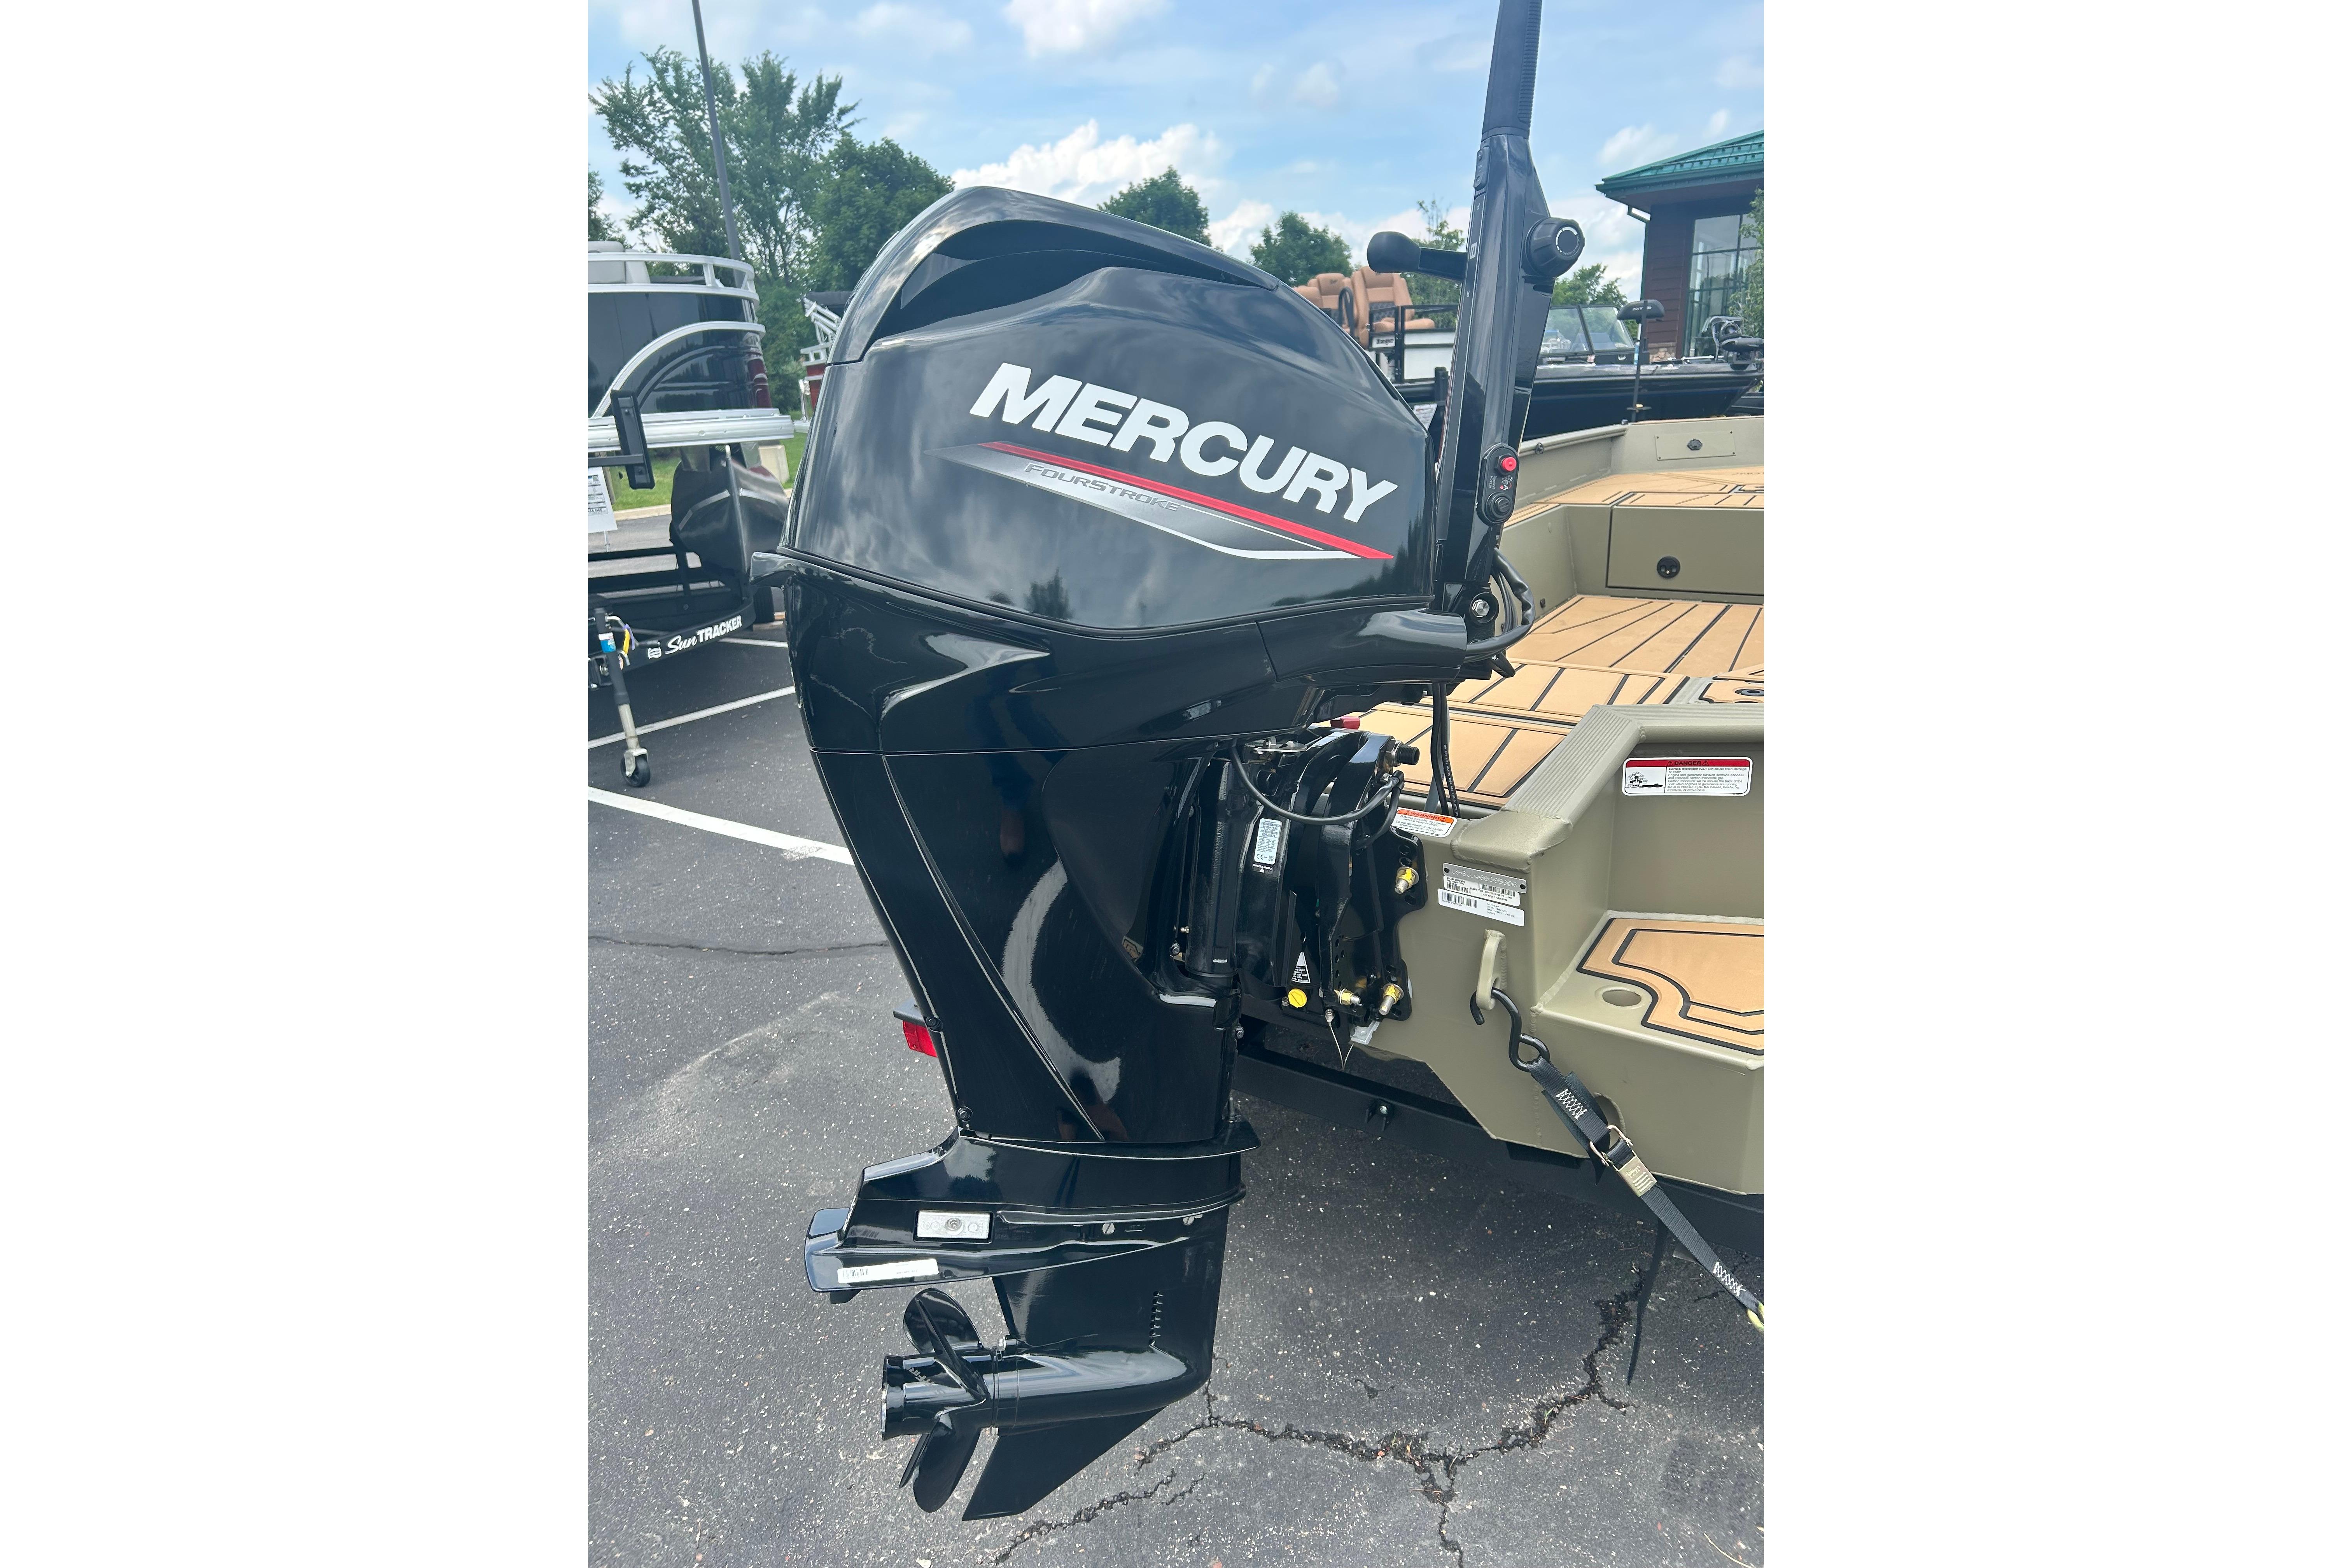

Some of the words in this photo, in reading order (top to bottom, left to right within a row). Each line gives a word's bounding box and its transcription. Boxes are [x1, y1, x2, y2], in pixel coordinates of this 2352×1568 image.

[1471, 245, 1475, 256] N
[970, 362, 1398, 523] MERCURY
[665, 635, 698, 654] Sun
[696, 615, 742, 643] TRACKER
